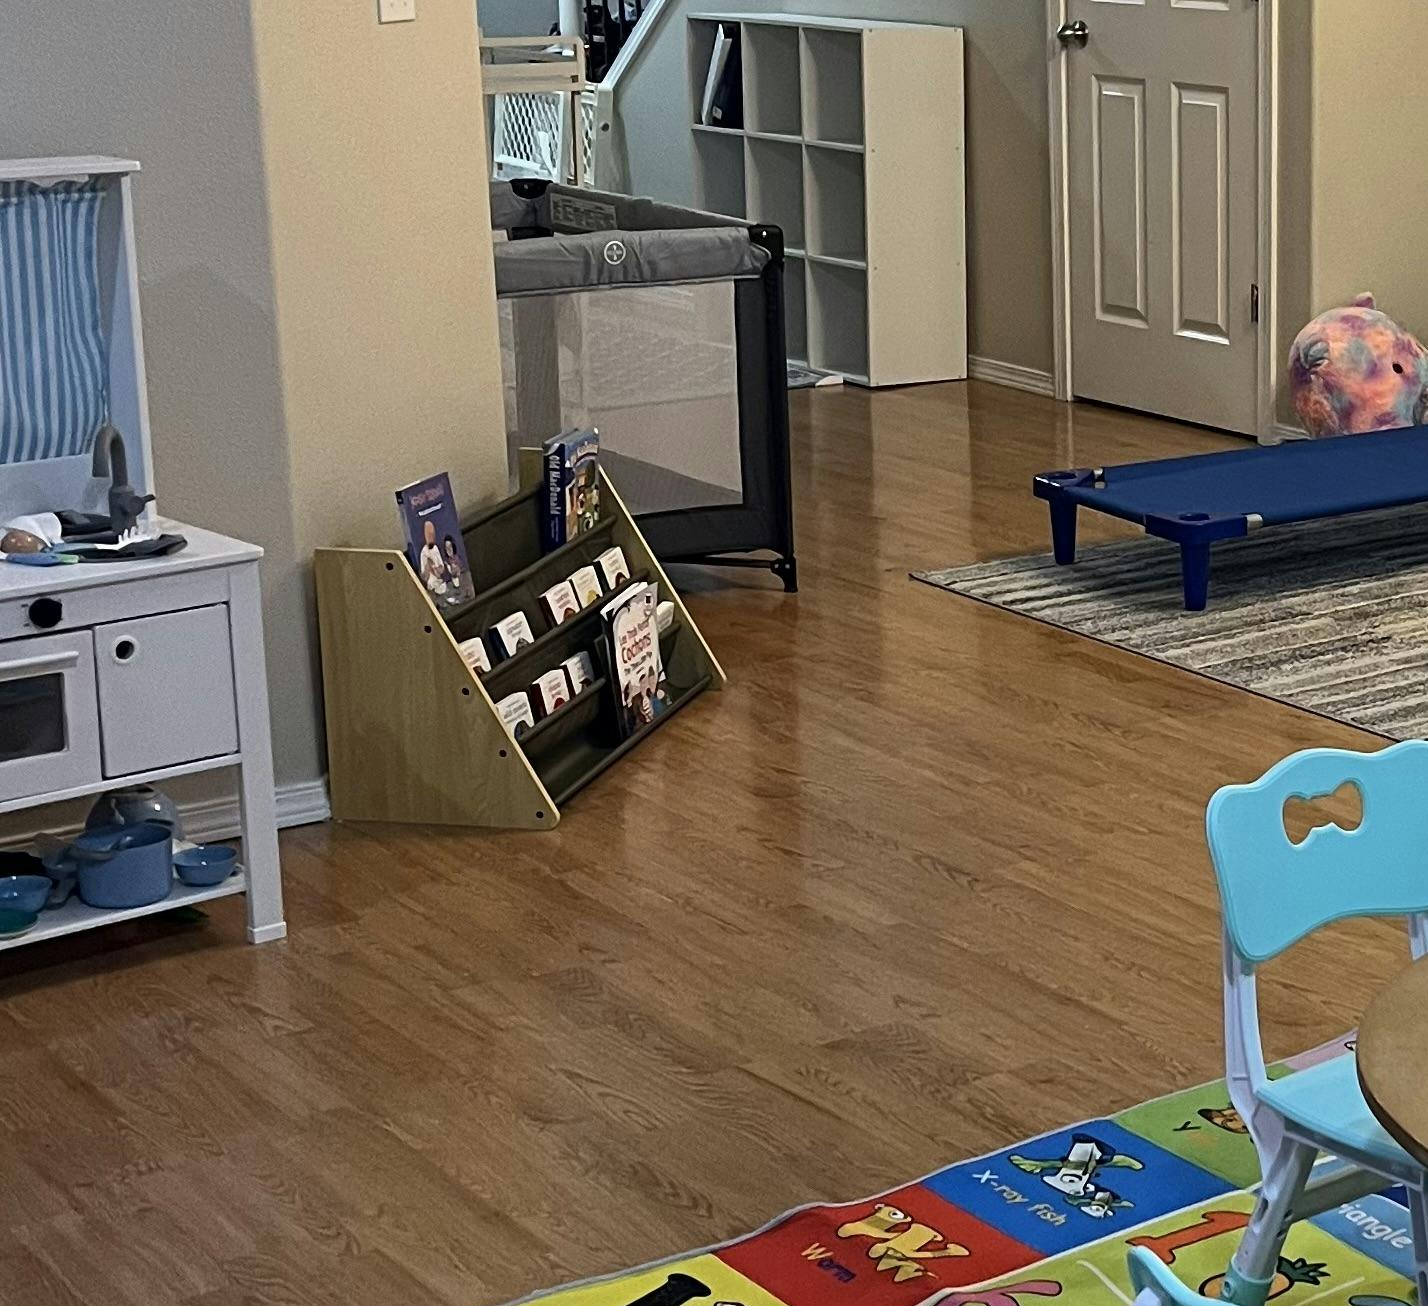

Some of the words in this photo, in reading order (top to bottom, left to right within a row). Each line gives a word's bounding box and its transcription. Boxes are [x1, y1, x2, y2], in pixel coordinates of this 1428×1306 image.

[971, 1168, 1030, 1205] X-ray
[1027, 1202, 1068, 1227] fish
[1338, 1203, 1413, 1249] iangle
[801, 1242, 857, 1283] Worm
